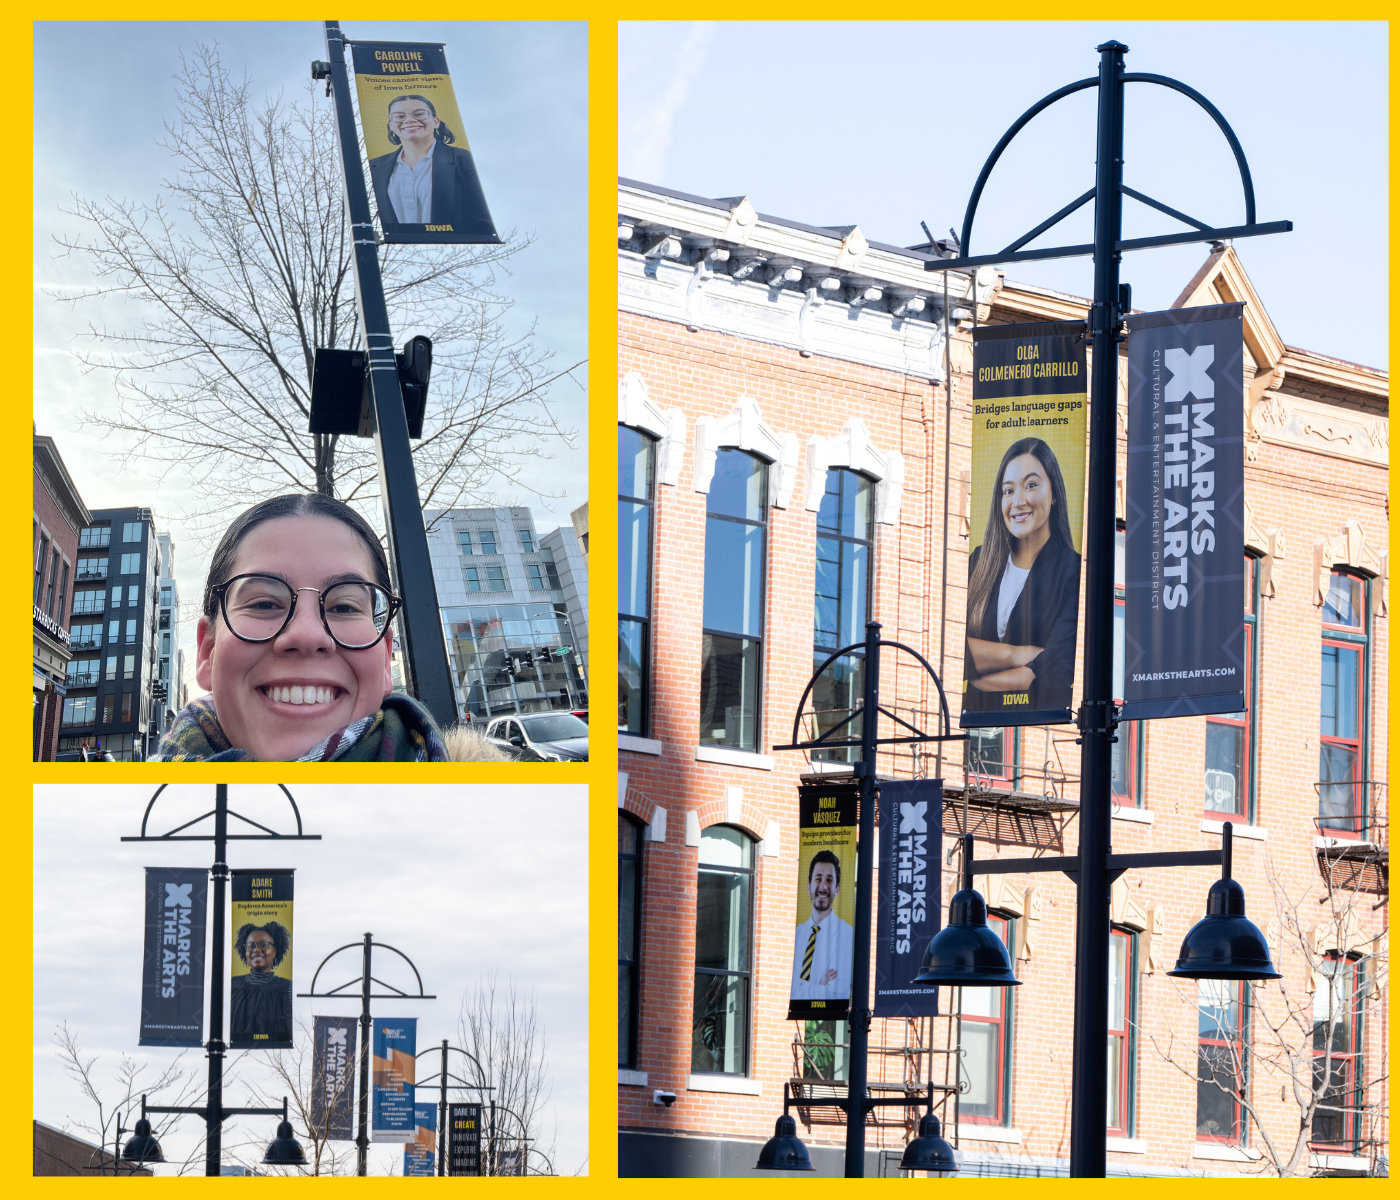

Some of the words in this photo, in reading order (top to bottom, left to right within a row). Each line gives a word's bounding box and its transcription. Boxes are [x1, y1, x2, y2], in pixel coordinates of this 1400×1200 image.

[374, 50, 423, 61] CAROLINE
[381, 62, 422, 73] POWELL
[424, 224, 454, 232] IOWA
[1016, 344, 1039, 361] OLGA
[978, 363, 1032, 382] COLMENERO
[1033, 361, 1079, 378] CARRILLO
[1164, 344, 1215, 403] X
[1152, 349, 1161, 418] CULTURAL
[975, 403, 1010, 415] Bridges
[1012, 401, 1056, 413] language
[1057, 400, 1083, 412] gaps
[986, 419, 1000, 429] for
[1001, 416, 1027, 428] adult
[1027, 416, 1069, 427] learners
[1152, 421, 1160, 430] &
[1163, 404, 1189, 490] THE
[1190, 401, 1216, 555] MARKS
[1151, 434, 1161, 546] ENTERTAINMENT
[1162, 497, 1189, 611] ARTS
[1151, 551, 1160, 611] DISTRICT
[33, 604, 58, 635] STARBUCKS
[1132, 667, 1236, 682] XMARKSTHEARTS.COM
[1002, 693, 1030, 706] IOWA
[818, 796, 837, 809] NOAH
[812, 807, 841, 825] VÁSQUEZ
[899, 801, 928, 834] X
[801, 830, 819, 839] Equips
[820, 829, 842, 838] providers
[823, 838, 849, 846] healthcare
[898, 835, 913, 885] THE
[251, 877, 273, 888] ADARE
[890, 851, 898, 917] ENTERTAINMENT
[911, 834, 928, 923] MARKS
[164, 882, 193, 908] X
[251, 889, 273, 899] SMITH
[163, 908, 178, 946] THE
[896, 888, 912, 955] ARTS
[176, 908, 192, 976] MARKS
[161, 947, 176, 999] ARTS
[878, 987, 935, 996] XMARKSTHEARTS.COM
[810, 1000, 827, 1008] IOWA
[327, 1027, 347, 1045] X
[326, 1045, 337, 1071] THE
[335, 1045, 347, 1093] MARKS
[453, 1107, 468, 1117] DARE
[469, 1107, 477, 1116] TO
[454, 1120, 476, 1129] CREATE
[452, 1133, 478, 1142] INNOVATE
[453, 1145, 477, 1154] EXPLORE
[453, 1158, 477, 1167] IMAGINE
